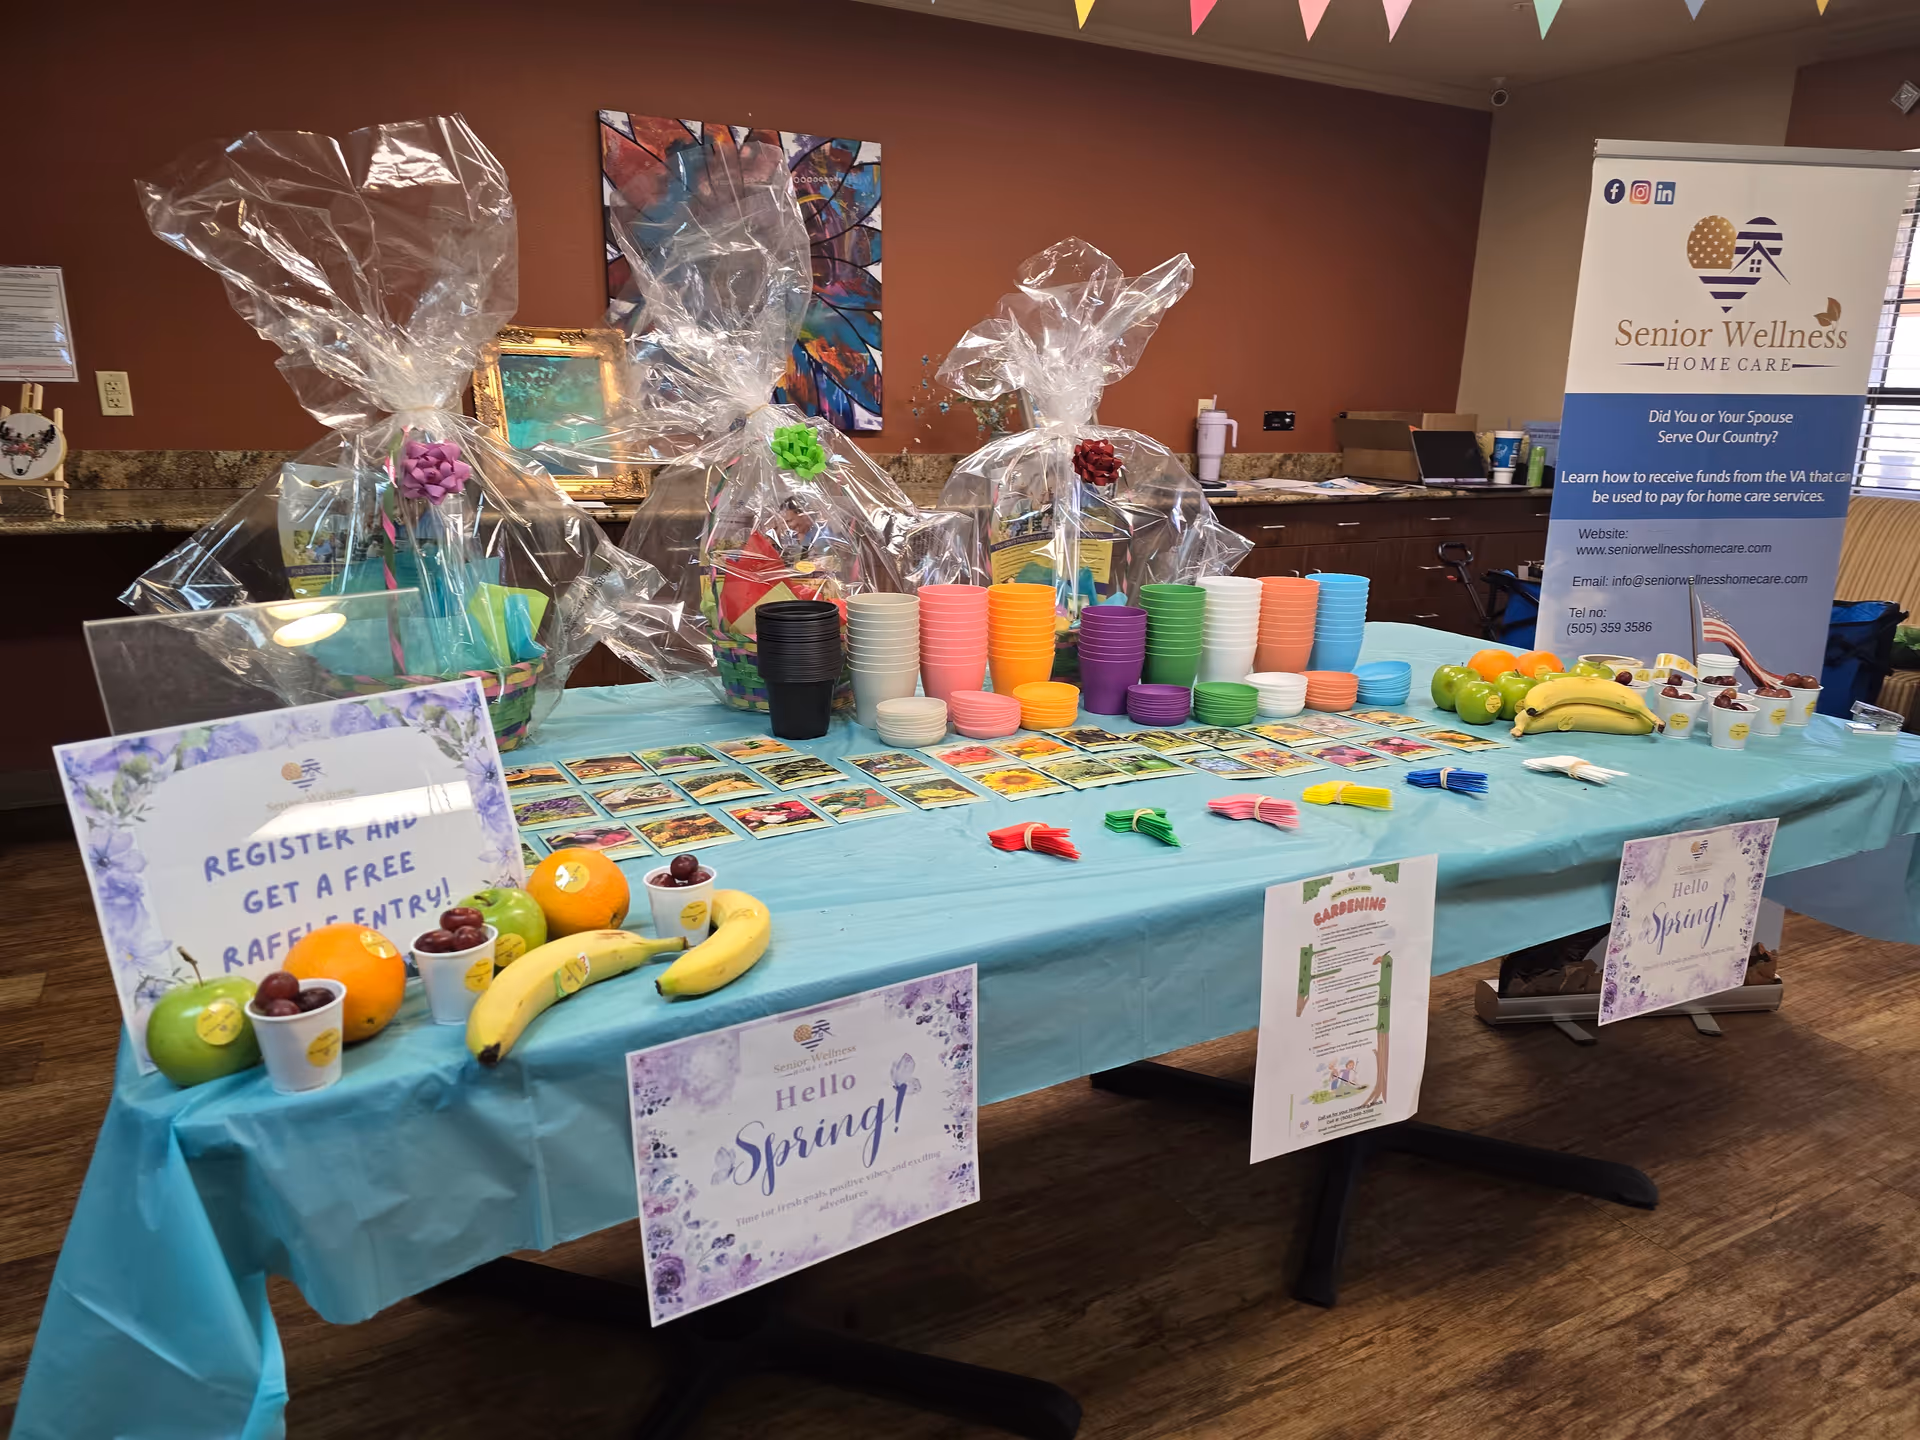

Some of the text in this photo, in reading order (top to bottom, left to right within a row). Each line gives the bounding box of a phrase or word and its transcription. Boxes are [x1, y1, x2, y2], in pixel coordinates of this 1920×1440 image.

[1614, 319, 1848, 349] Senior Wellness
[1666, 357, 1792, 372] HOME CARE
[1648, 410, 1794, 427] Did You or Your Spouse
[1657, 430, 1779, 447] Serve Our Country?
[1561, 470, 1851, 484] Learn how to receive funds from the VA that can
[1592, 490, 1825, 506] be used to pay for home care services.
[1578, 528, 1629, 540] Website:
[1576, 543, 1772, 556] www.seniorwellnesshomecare.com
[1572, 574, 1808, 588] Email: info@seniorwellnesshomecare.com
[1569, 608, 1607, 618] Tel no:
[1566, 621, 1653, 636] (505) 359 3586
[203, 812, 418, 882] REGISTER AND
[243, 850, 416, 914] GET A FREE
[1671, 878, 1709, 899] Hello
[353, 876, 453, 931] ENTRY!
[1314, 897, 1386, 926] GARDENING
[1647, 893, 1730, 956] Spring!
[773, 1045, 857, 1074] Senior Wellness
[775, 1073, 857, 1112] Hello
[733, 1083, 908, 1197] Spring!
[735, 1213, 760, 1228] Time
[776, 1197, 802, 1213] fresh
[829, 1176, 865, 1197] positive
[891, 1161, 906, 1174] and
[818, 1190, 869, 1213] adventures
